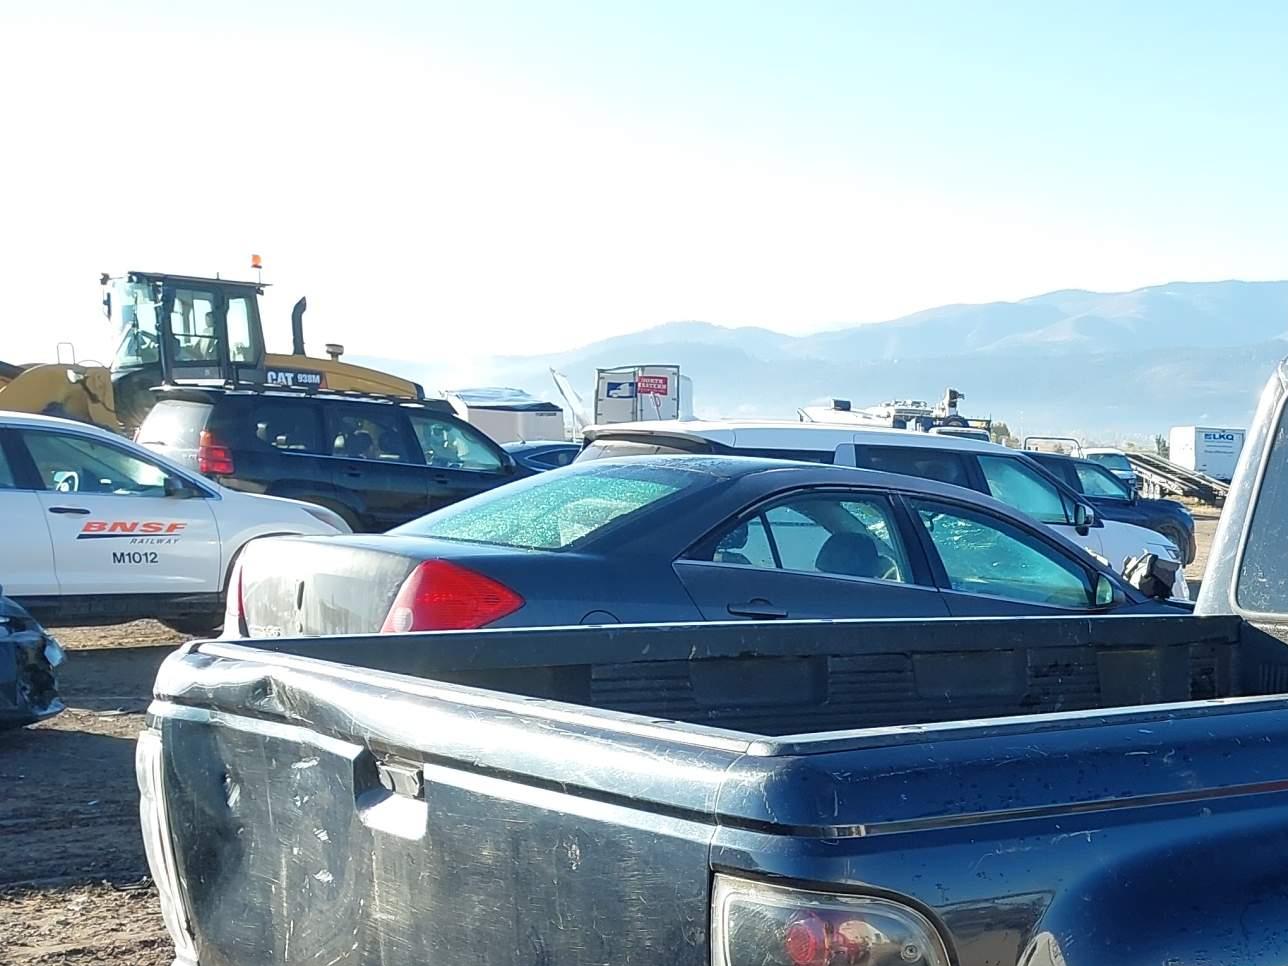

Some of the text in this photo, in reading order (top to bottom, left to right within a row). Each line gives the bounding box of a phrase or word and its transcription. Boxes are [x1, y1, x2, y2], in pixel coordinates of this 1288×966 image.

[267, 371, 321, 386] CAT 938M
[1213, 433, 1234, 441] LKQ
[81, 521, 188, 533] BNSF
[112, 551, 159, 564] M1012
